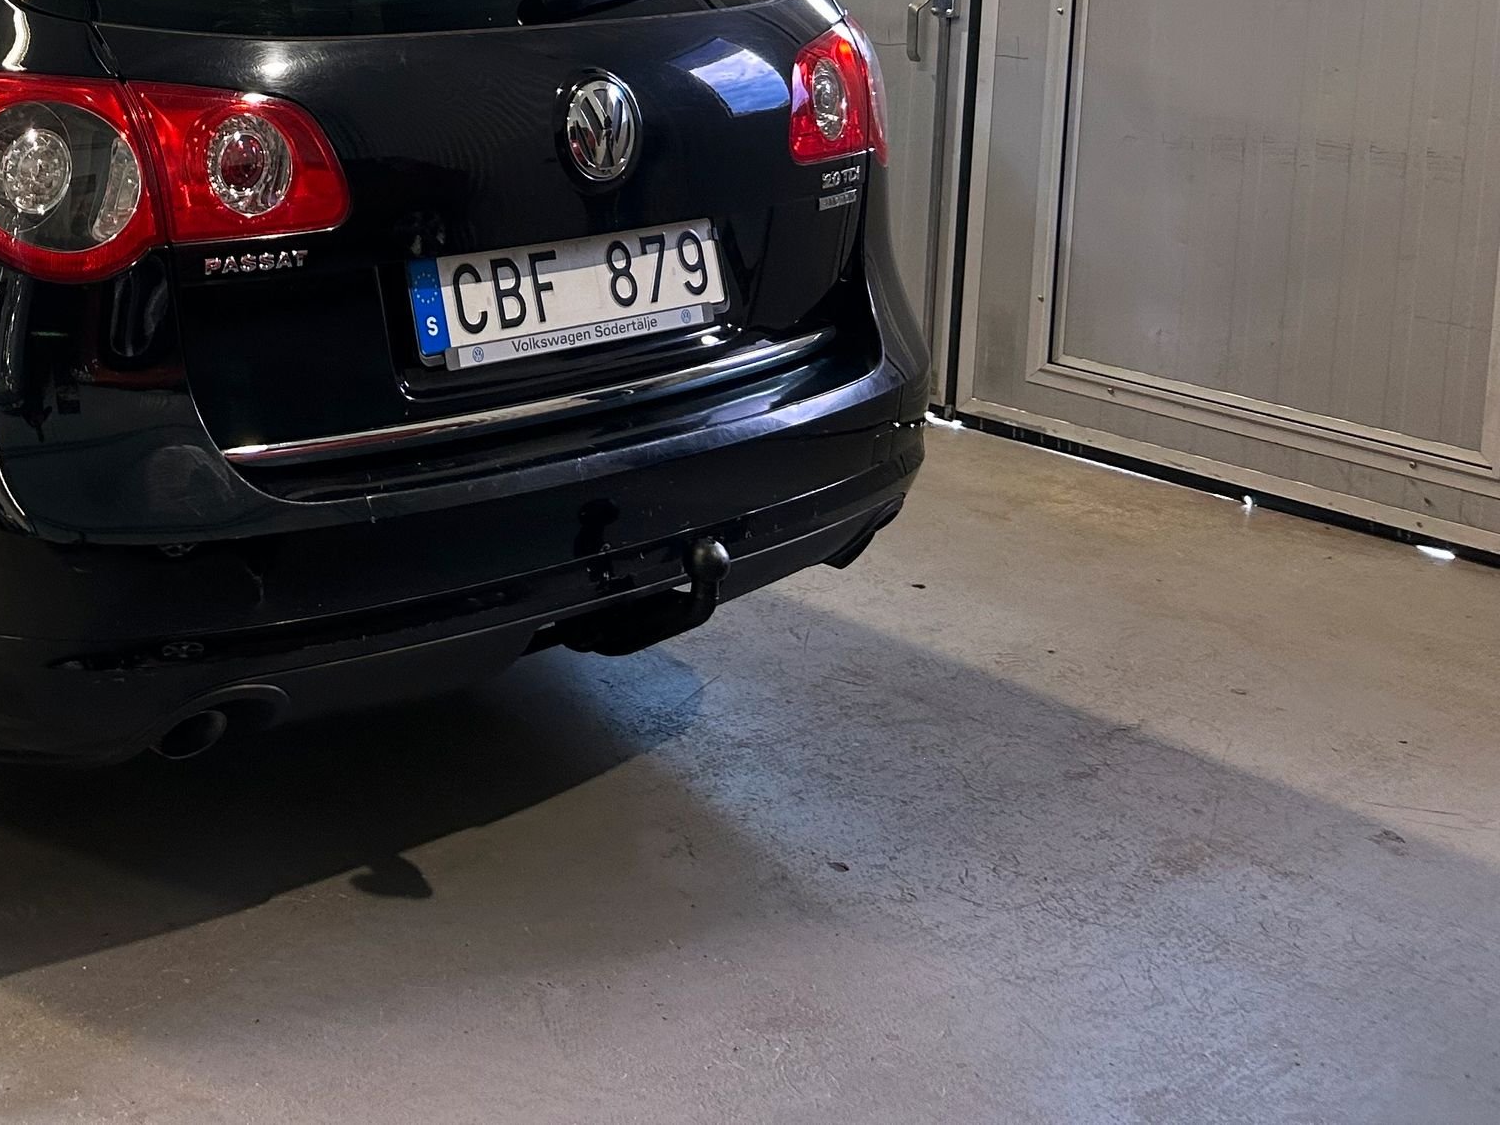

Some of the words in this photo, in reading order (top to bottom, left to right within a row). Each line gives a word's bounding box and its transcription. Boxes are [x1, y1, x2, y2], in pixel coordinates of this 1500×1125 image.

[204, 250, 308, 275] PASSAT
[426, 316, 439, 337] S
[452, 249, 556, 334] CBF
[606, 229, 708, 307] 879
[511, 328, 592, 353] Volkswagen
[594, 316, 658, 339] Södertälje
